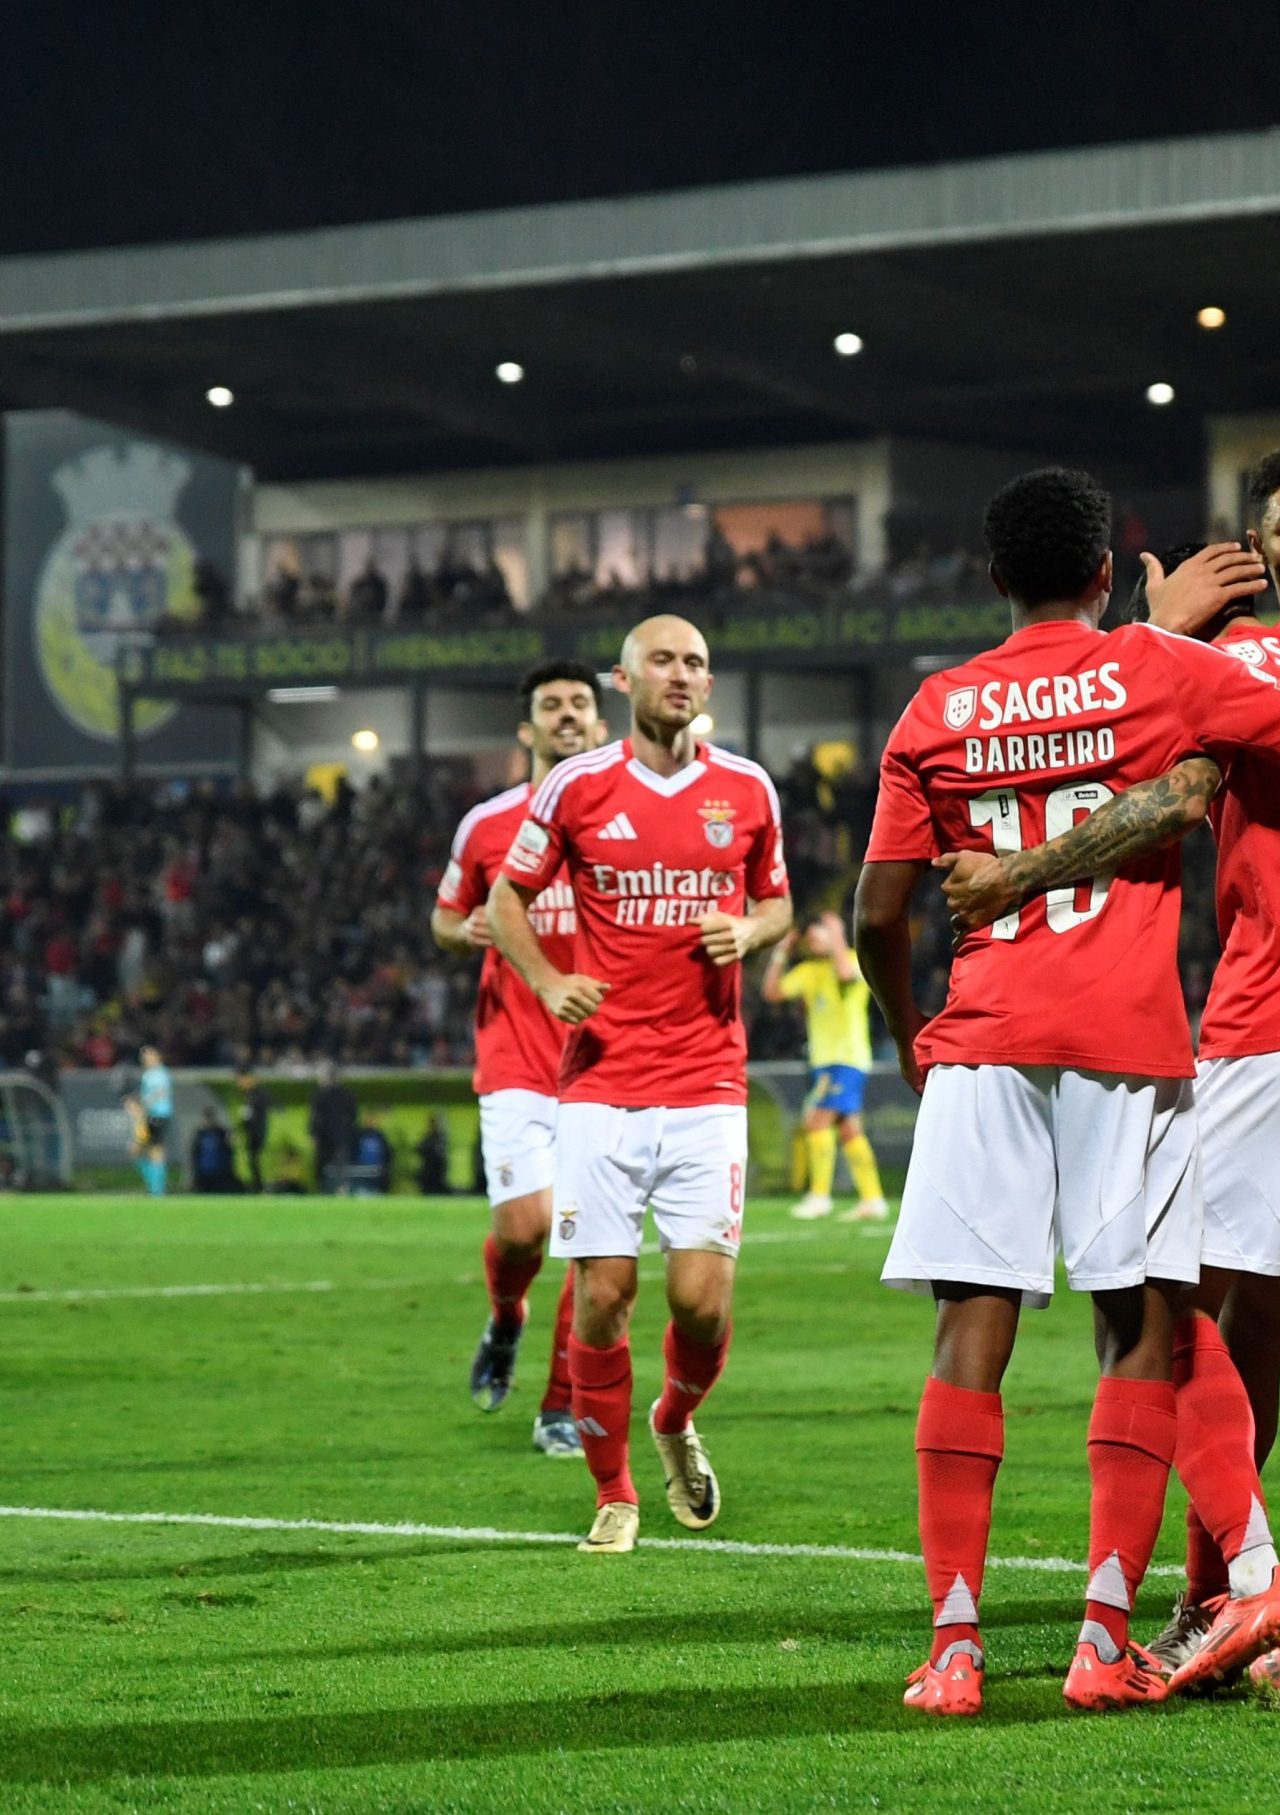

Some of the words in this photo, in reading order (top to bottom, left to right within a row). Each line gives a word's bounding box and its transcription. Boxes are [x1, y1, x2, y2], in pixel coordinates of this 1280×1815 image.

[979, 662, 1127, 730] SAGRES
[964, 728, 1116, 774] BARREIRO
[615, 899, 650, 926] FLY
[730, 1162, 742, 1214] 8
